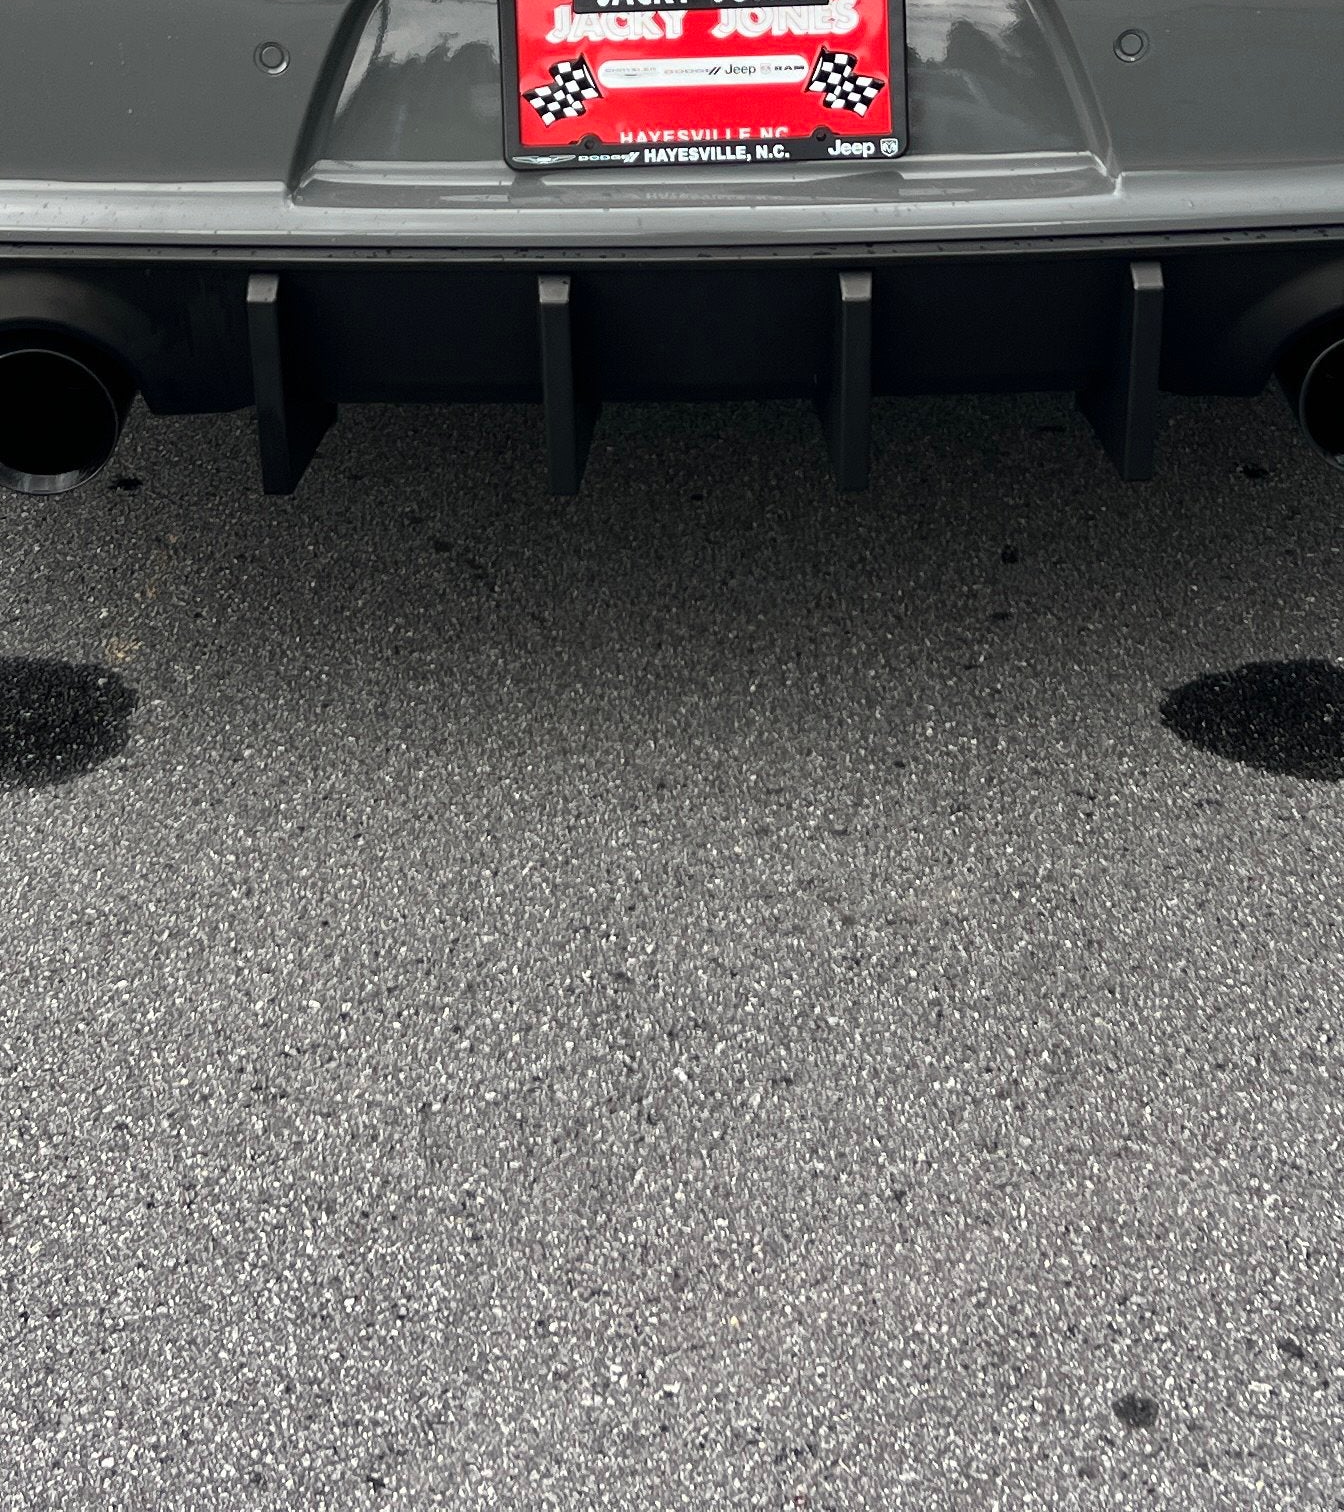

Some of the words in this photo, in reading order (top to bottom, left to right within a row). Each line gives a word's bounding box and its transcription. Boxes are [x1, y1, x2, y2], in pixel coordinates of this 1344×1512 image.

[545, 4, 688, 44] JACKY
[725, 63, 757, 76] Jeep
[644, 145, 752, 163] HAYESVILLE,
[756, 144, 790, 159] N.C.
[827, 140, 876, 158] Jeep
